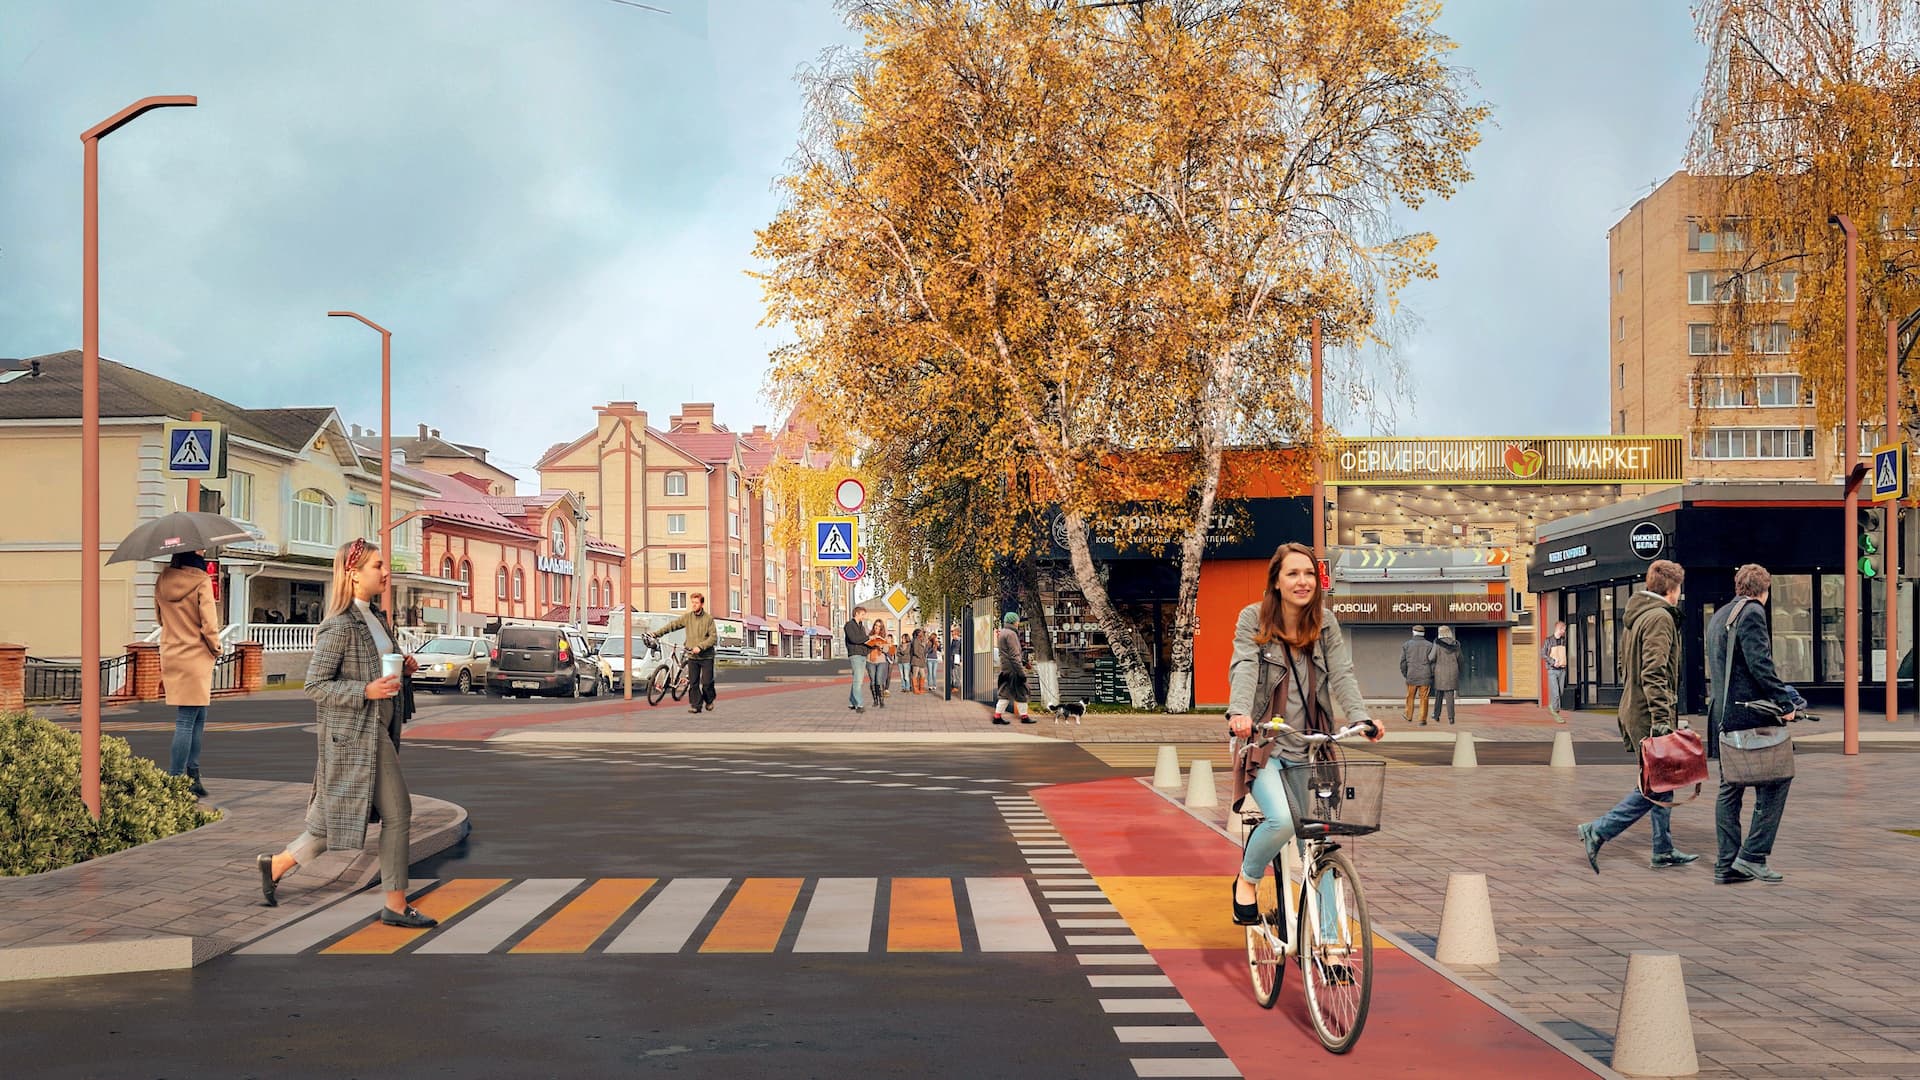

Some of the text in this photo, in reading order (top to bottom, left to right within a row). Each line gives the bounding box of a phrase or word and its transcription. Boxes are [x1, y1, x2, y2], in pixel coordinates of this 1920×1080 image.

[1340, 445, 1652, 472] ФЕРМЕРСКИЙ МАРКЕТ
[1096, 516, 1175, 529] ИСТОРИ
[1332, 603, 1377, 614] #ОВОЩИ
[1392, 603, 1432, 612] #СЫРЫ
[1449, 602, 1502, 612] #МОЛОКО
